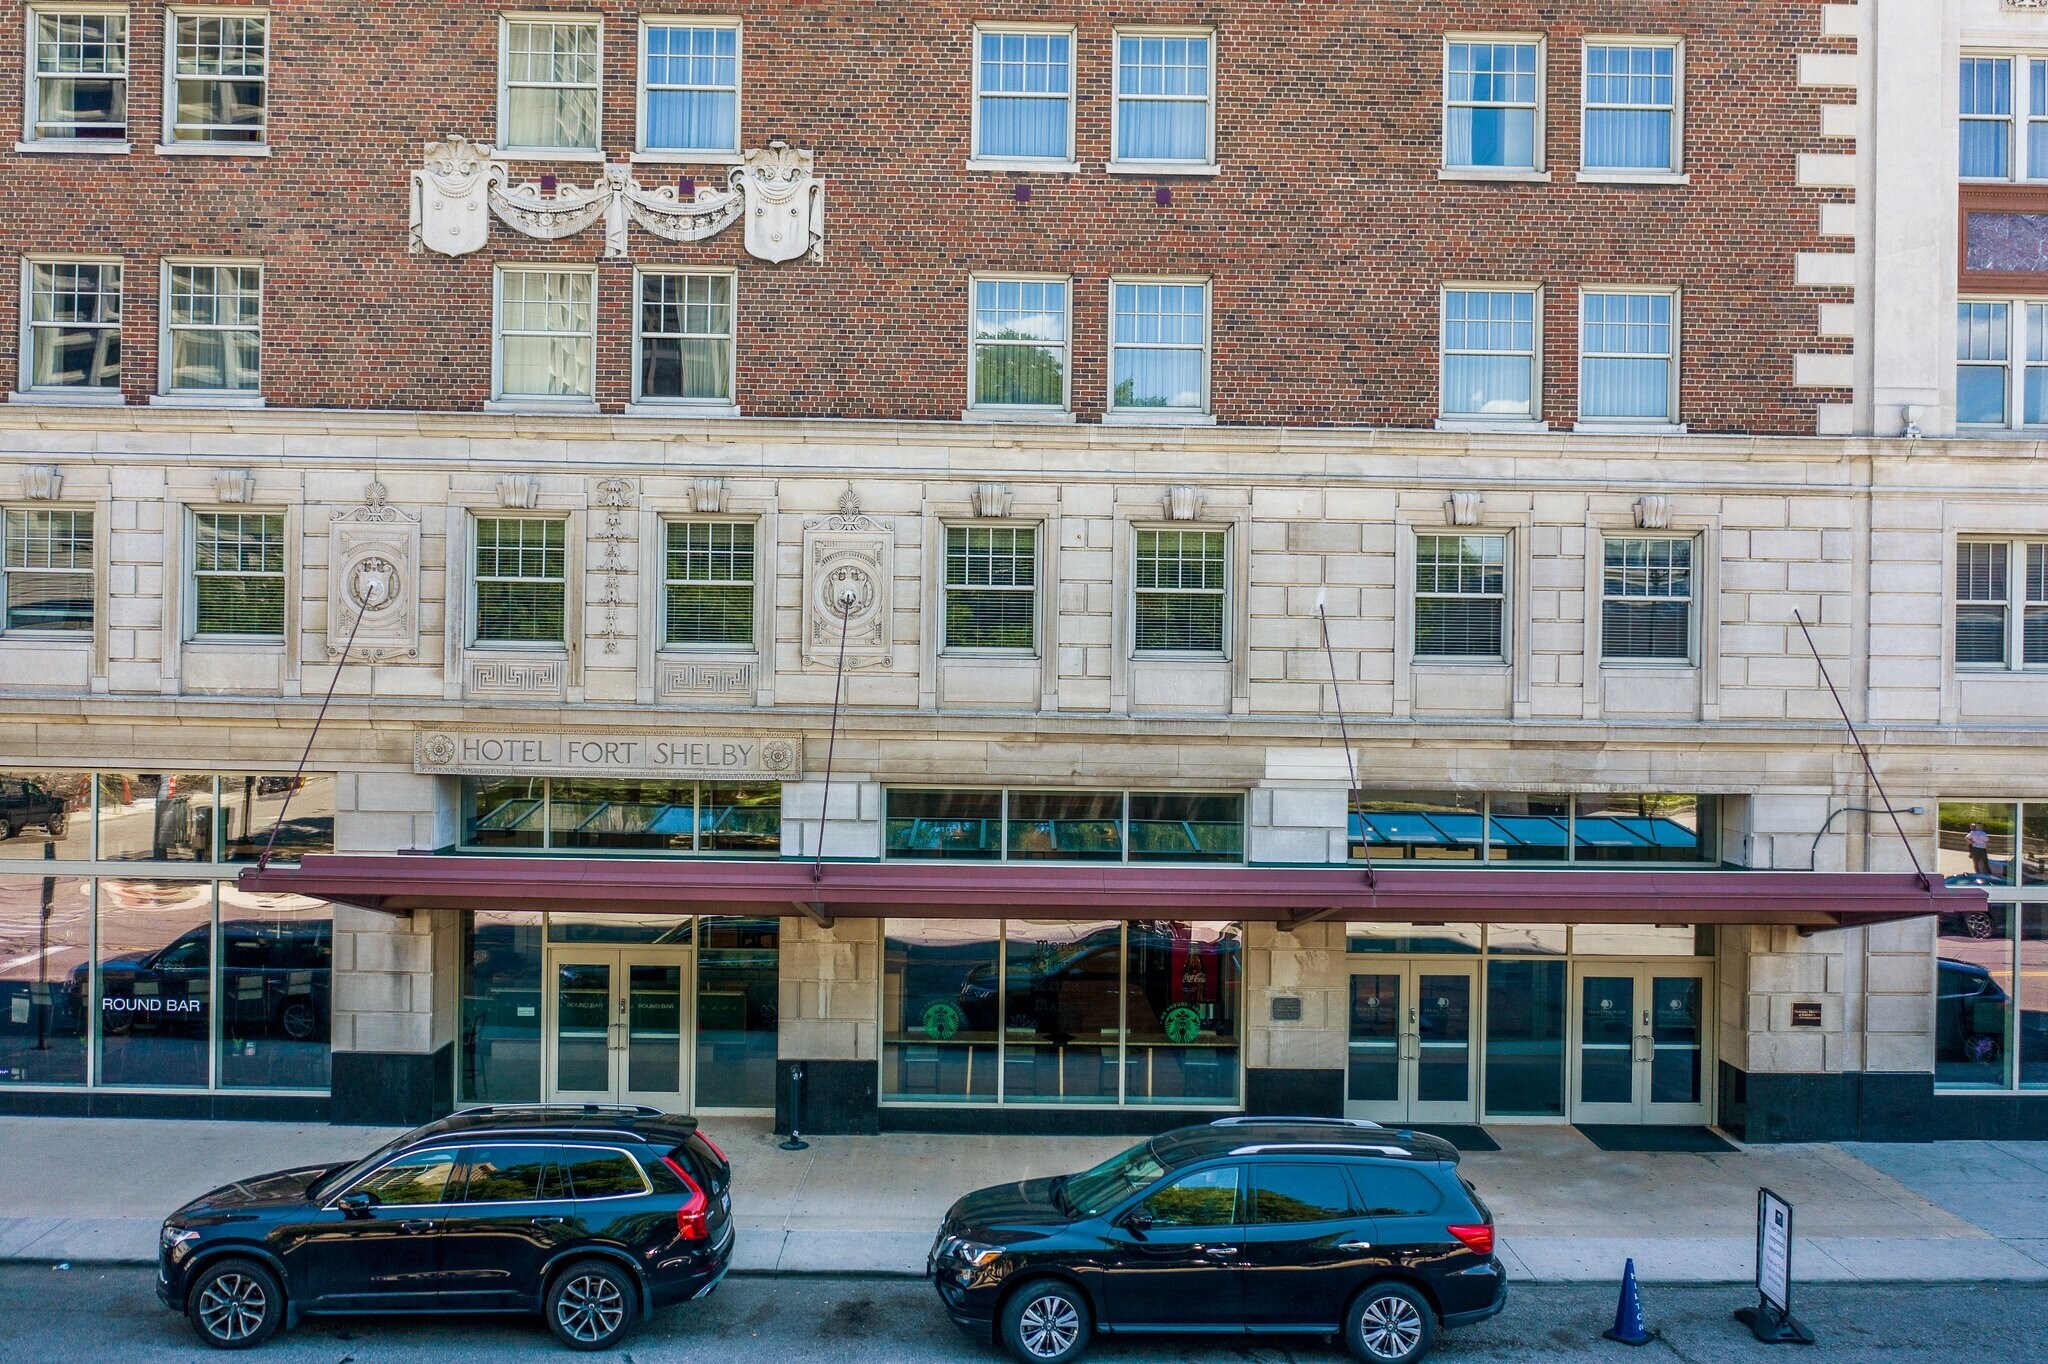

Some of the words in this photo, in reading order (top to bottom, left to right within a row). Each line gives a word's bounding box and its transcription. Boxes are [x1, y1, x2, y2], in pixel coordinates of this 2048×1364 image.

[463, 738, 552, 763] HOTEL
[568, 741, 637, 764] FORT
[653, 742, 754, 766] SHELBY
[102, 998, 161, 1011] ROUND
[166, 999, 200, 1012] BAR
